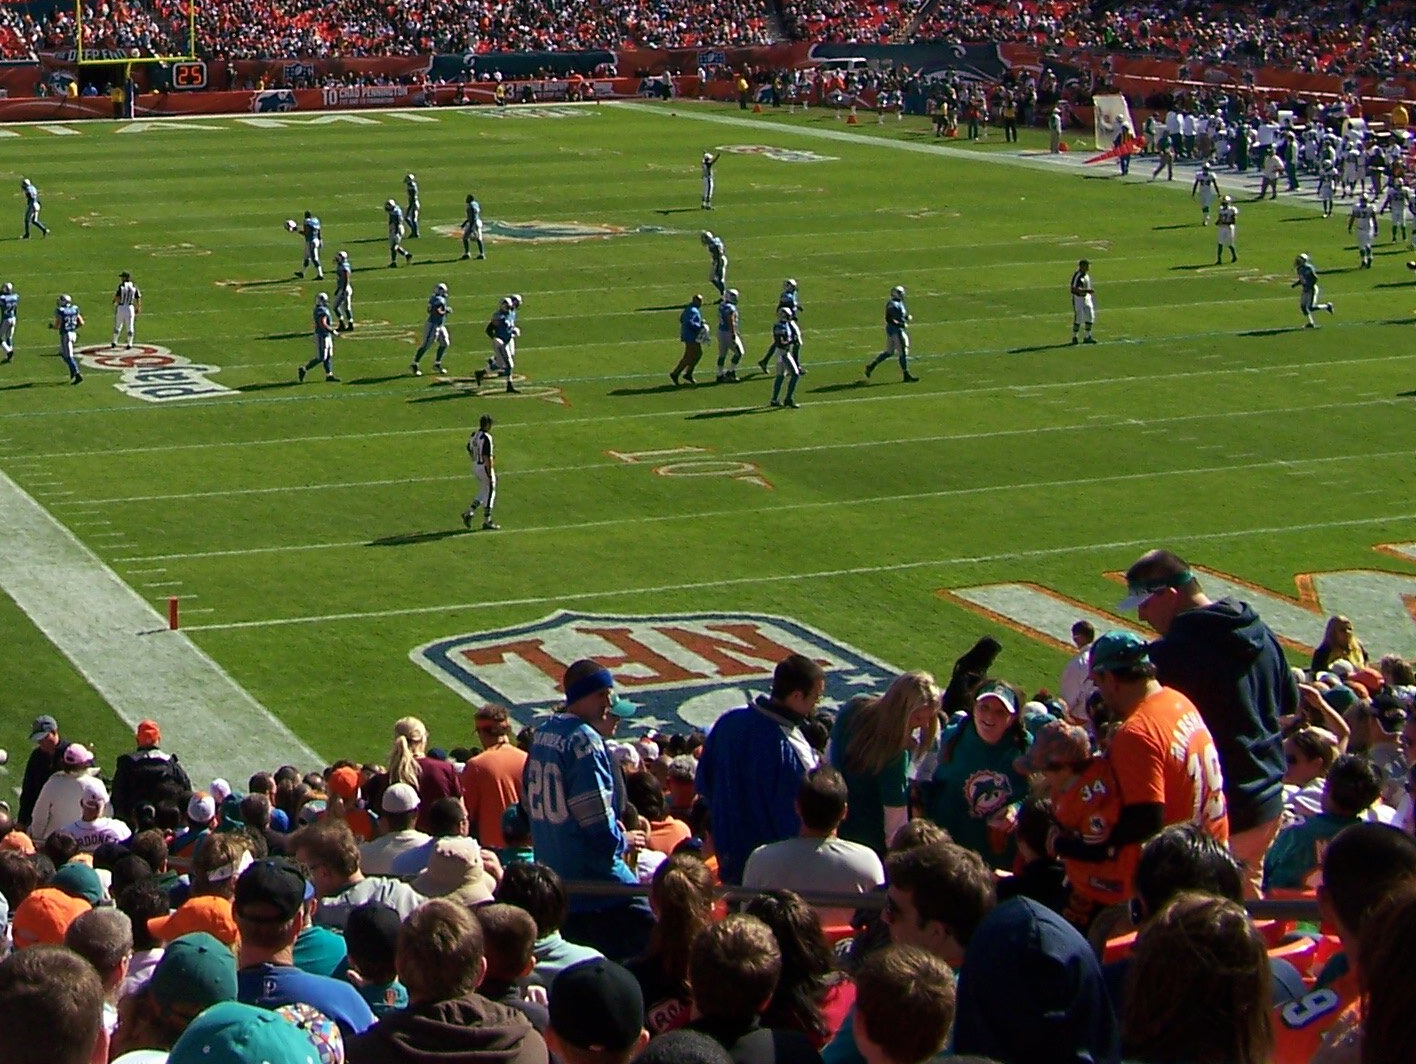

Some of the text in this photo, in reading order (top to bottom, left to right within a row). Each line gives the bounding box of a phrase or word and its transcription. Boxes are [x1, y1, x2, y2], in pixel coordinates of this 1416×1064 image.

[68, 49, 100, 62] DEP
[178, 66, 202, 85] 25
[322, 89, 338, 106] 10
[460, 624, 834, 694] NFL
[527, 758, 569, 825] 20
